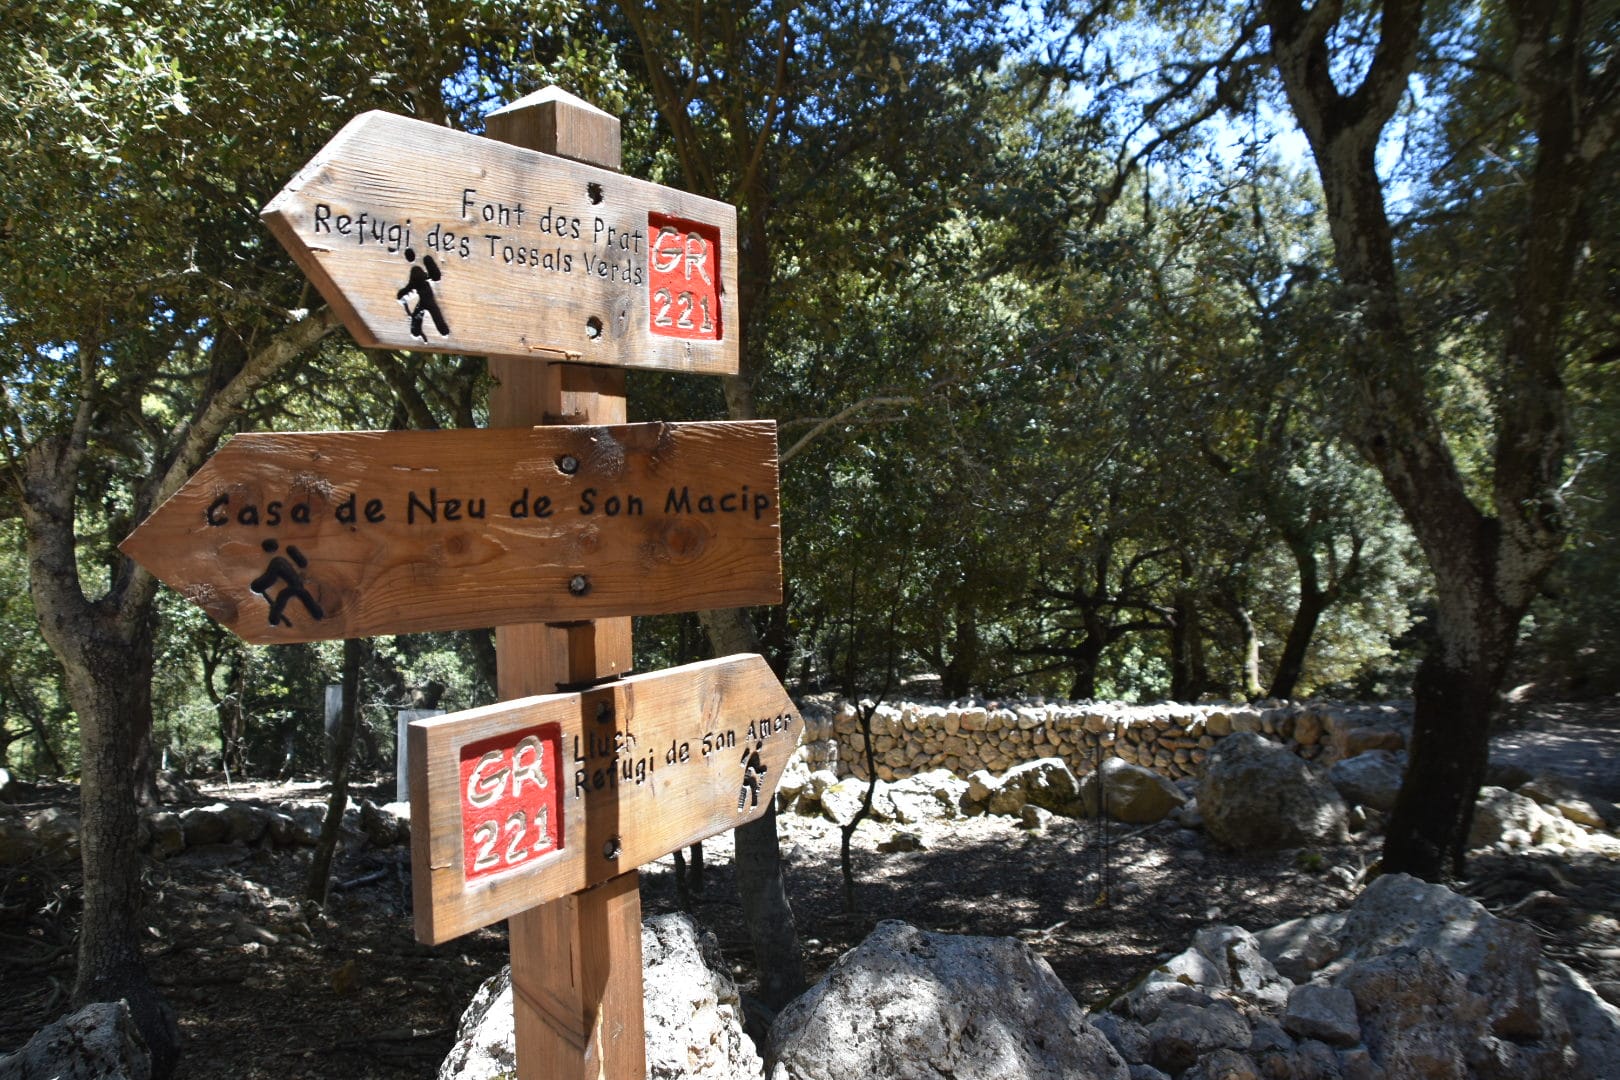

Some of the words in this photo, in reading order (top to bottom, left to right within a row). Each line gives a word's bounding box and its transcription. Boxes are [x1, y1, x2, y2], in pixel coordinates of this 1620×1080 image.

[314, 203, 411, 253] Refugi
[426, 223, 470, 259] des
[484, 234, 572, 273] Tossals
[584, 251, 643, 286] Verds
[462, 188, 525, 228] Font
[539, 206, 580, 239] des
[594, 216, 643, 254] Prat
[651, 225, 711, 285] GR
[653, 286, 713, 334] 221
[207, 493, 311, 527] Casa
[335, 493, 385, 526] de
[407, 488, 486, 524] Neu
[510, 487, 553, 519] de
[580, 488, 643, 516] Son
[665, 485, 770, 519] Macip
[467, 734, 548, 809] GR
[573, 730, 636, 765] Lluch
[575, 749, 655, 800] Refugi
[666, 741, 690, 767] de
[701, 731, 736, 759] Son
[747, 713, 793, 742] Amer
[472, 803, 552, 873] 221
